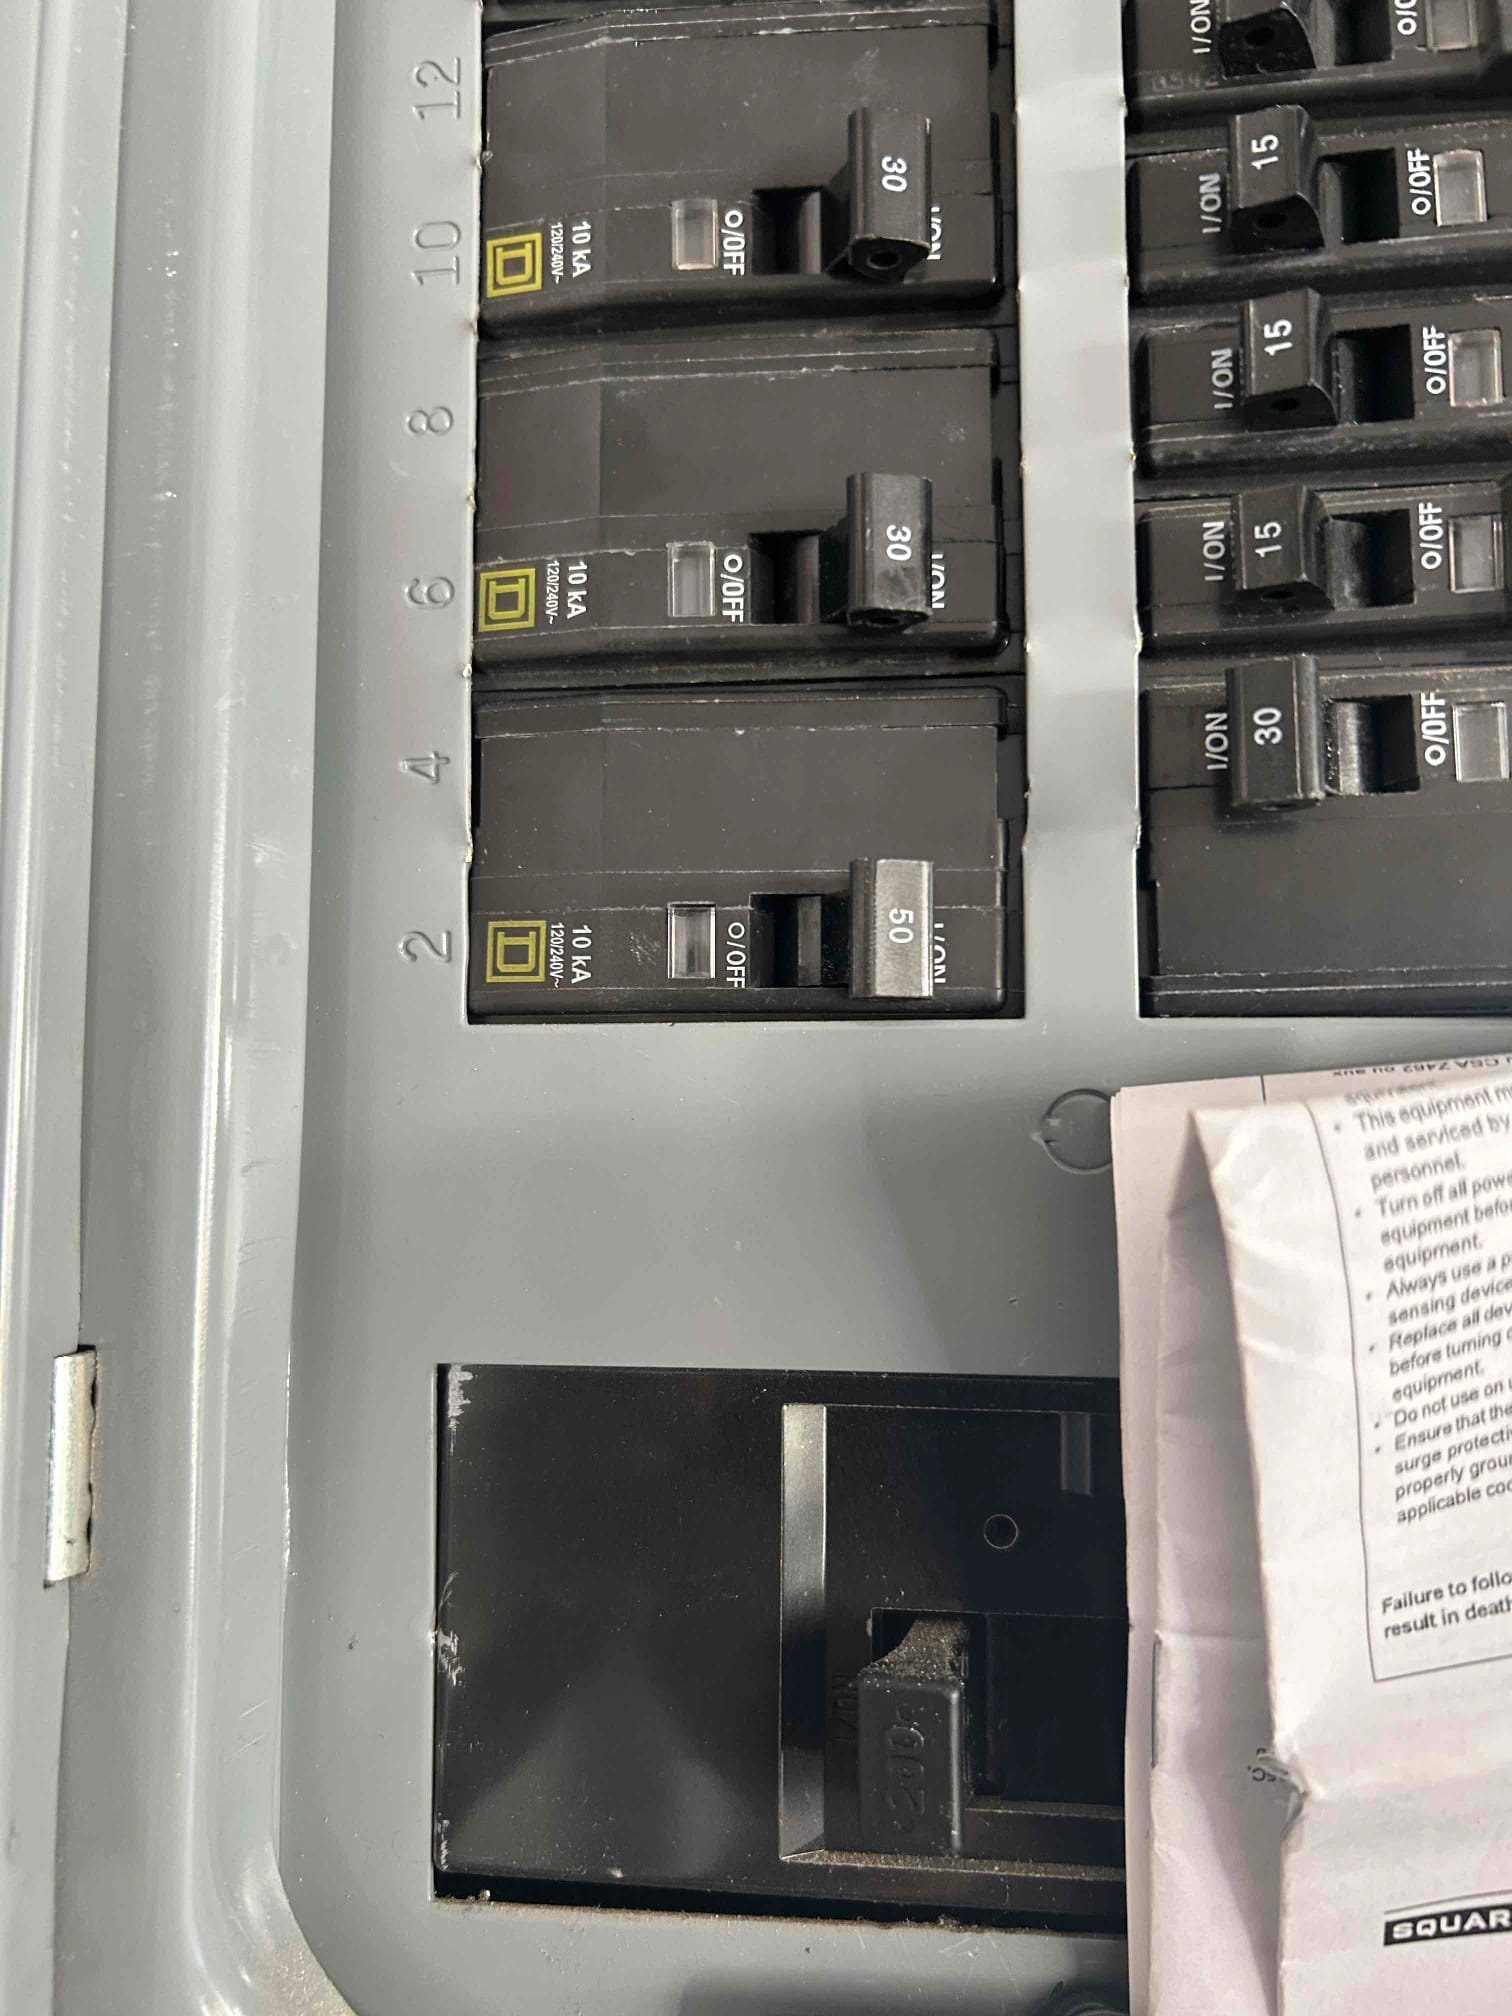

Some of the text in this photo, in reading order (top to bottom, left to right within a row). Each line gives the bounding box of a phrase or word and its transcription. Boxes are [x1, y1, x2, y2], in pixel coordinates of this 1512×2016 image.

[412, 56, 461, 120] 12
[881, 156, 907, 192] 30
[1251, 134, 1279, 171] 15
[1199, 172, 1223, 234] I/ON
[1407, 148, 1433, 216] O/OFF
[411, 220, 461, 287] 10
[571, 221, 592, 279] 10 kA
[721, 209, 745, 276] O/OFF
[1264, 319, 1293, 356] 15
[1422, 325, 1447, 395] O/OFF
[1211, 348, 1235, 410] I/ON
[405, 406, 454, 435] 8
[886, 524, 912, 561] 30
[1203, 520, 1226, 582] I/ON
[1254, 520, 1283, 558] 15
[1419, 501, 1444, 571] O/OFF
[404, 576, 456, 609] 6
[566, 562, 588, 620] 10 kA
[720, 554, 745, 624] O/OFF
[1205, 712, 1229, 770] I/ON
[1253, 706, 1283, 746] 30
[1420, 691, 1449, 767] O/OFF
[399, 751, 450, 785] 4
[398, 930, 452, 964] 2
[888, 908, 914, 944] 50
[571, 925, 592, 984] 10 kA
[726, 922, 746, 989] O/OFF
[1353, 1108, 1398, 1133] This
[1398, 1087, 1492, 1122] equipment
[1364, 1113, 1511, 1162] and serviced by
[1376, 1194, 1419, 1217] Turn
[1422, 1183, 1444, 1208] off
[1448, 1178, 1467, 1200] all
[1380, 1207, 1470, 1246] equipment
[1386, 1271, 1447, 1301] Always
[1451, 1261, 1482, 1281] use
[1486, 1256, 1497, 1272] a
[1388, 1295, 1456, 1326] sensing
[1388, 1320, 1457, 1353] Replace
[1462, 1308, 1480, 1329] all
[1389, 1350, 1442, 1377] before
[1446, 1332, 1501, 1359] turning
[1393, 1408, 1418, 1428] Do
[1421, 1396, 1447, 1421] not
[1450, 1388, 1479, 1408] use
[1484, 1380, 1504, 1397] on
[1394, 1399, 1512, 1452] Ensure that the
[1394, 1425, 1512, 1476] surge protecti
[1395, 1464, 1464, 1503] properly
[1397, 1485, 1482, 1525] applicable
[1382, 1569, 1512, 1616] Failure to follo
[1384, 1612, 1438, 1640] result
[1441, 1609, 1460, 1627] in
[1392, 1908, 1512, 1940] SQUAR
